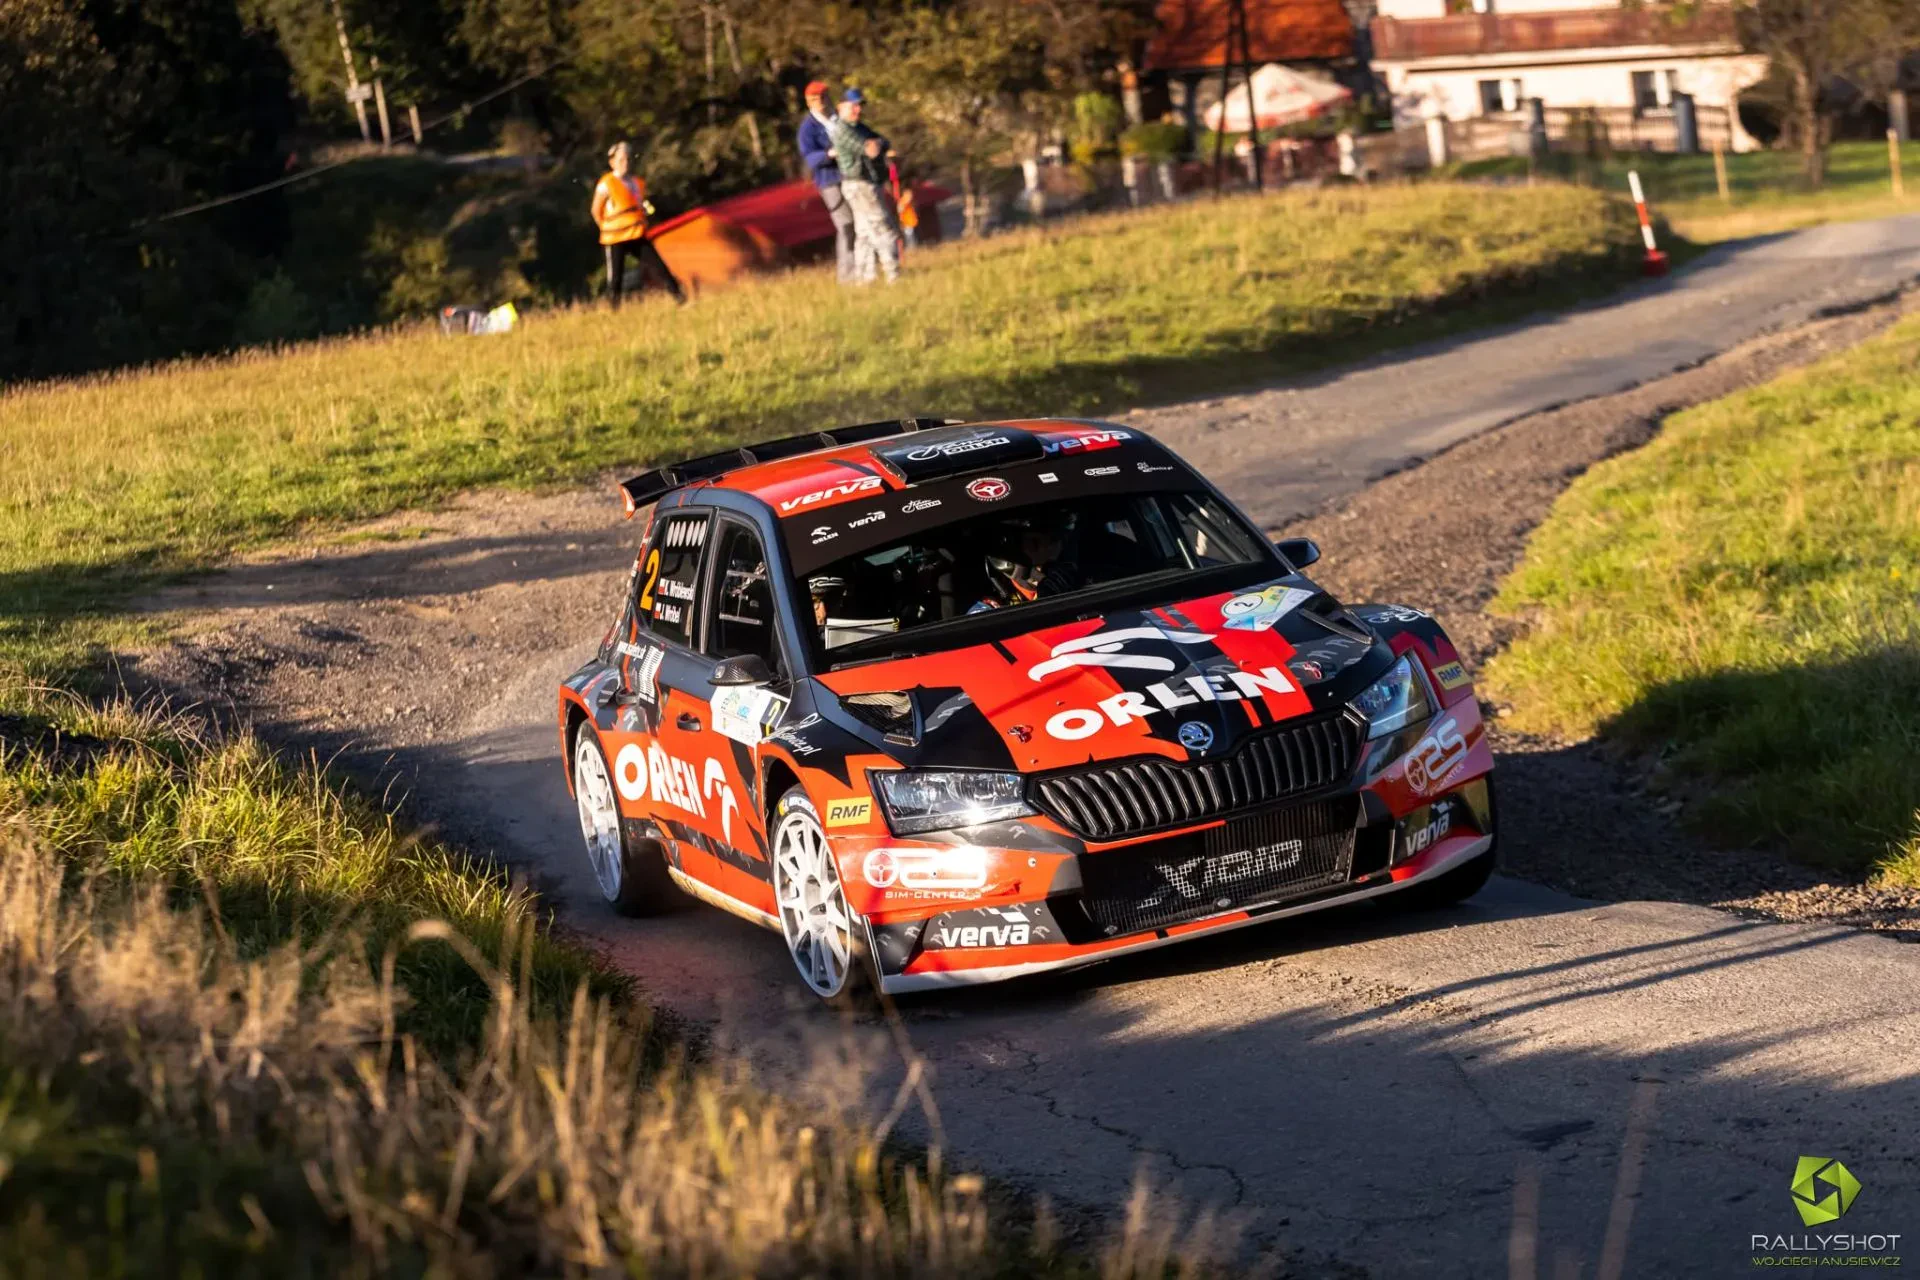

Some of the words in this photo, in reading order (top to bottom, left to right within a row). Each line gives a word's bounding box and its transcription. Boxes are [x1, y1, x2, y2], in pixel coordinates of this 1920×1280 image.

[1043, 430, 1132, 453] verva
[780, 474, 882, 510] verva
[848, 511, 886, 529] verva
[812, 532, 838, 545] ORLEN
[640, 548, 660, 611] 2
[1438, 667, 1464, 684] RMF
[1046, 667, 1296, 741] ORLEN
[614, 740, 706, 819] ORLEN
[830, 804, 868, 820] RMF
[1405, 813, 1449, 857] verva
[940, 923, 1029, 948] verva
